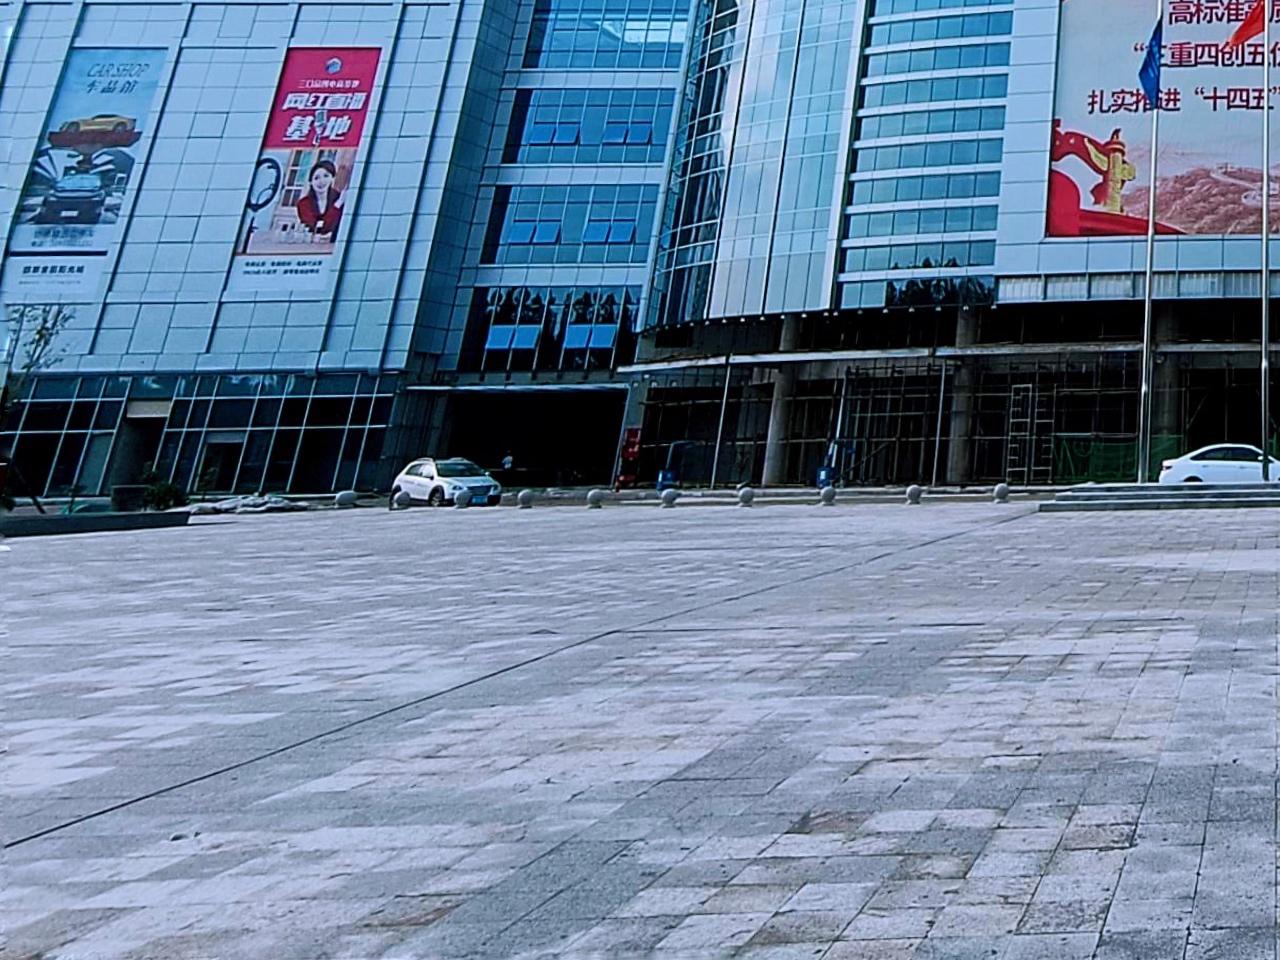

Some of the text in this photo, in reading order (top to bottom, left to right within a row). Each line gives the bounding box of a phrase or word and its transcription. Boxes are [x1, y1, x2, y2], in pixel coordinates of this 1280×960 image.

[282, 92, 367, 110] 网红直播
[282, 115, 351, 141] 基地
